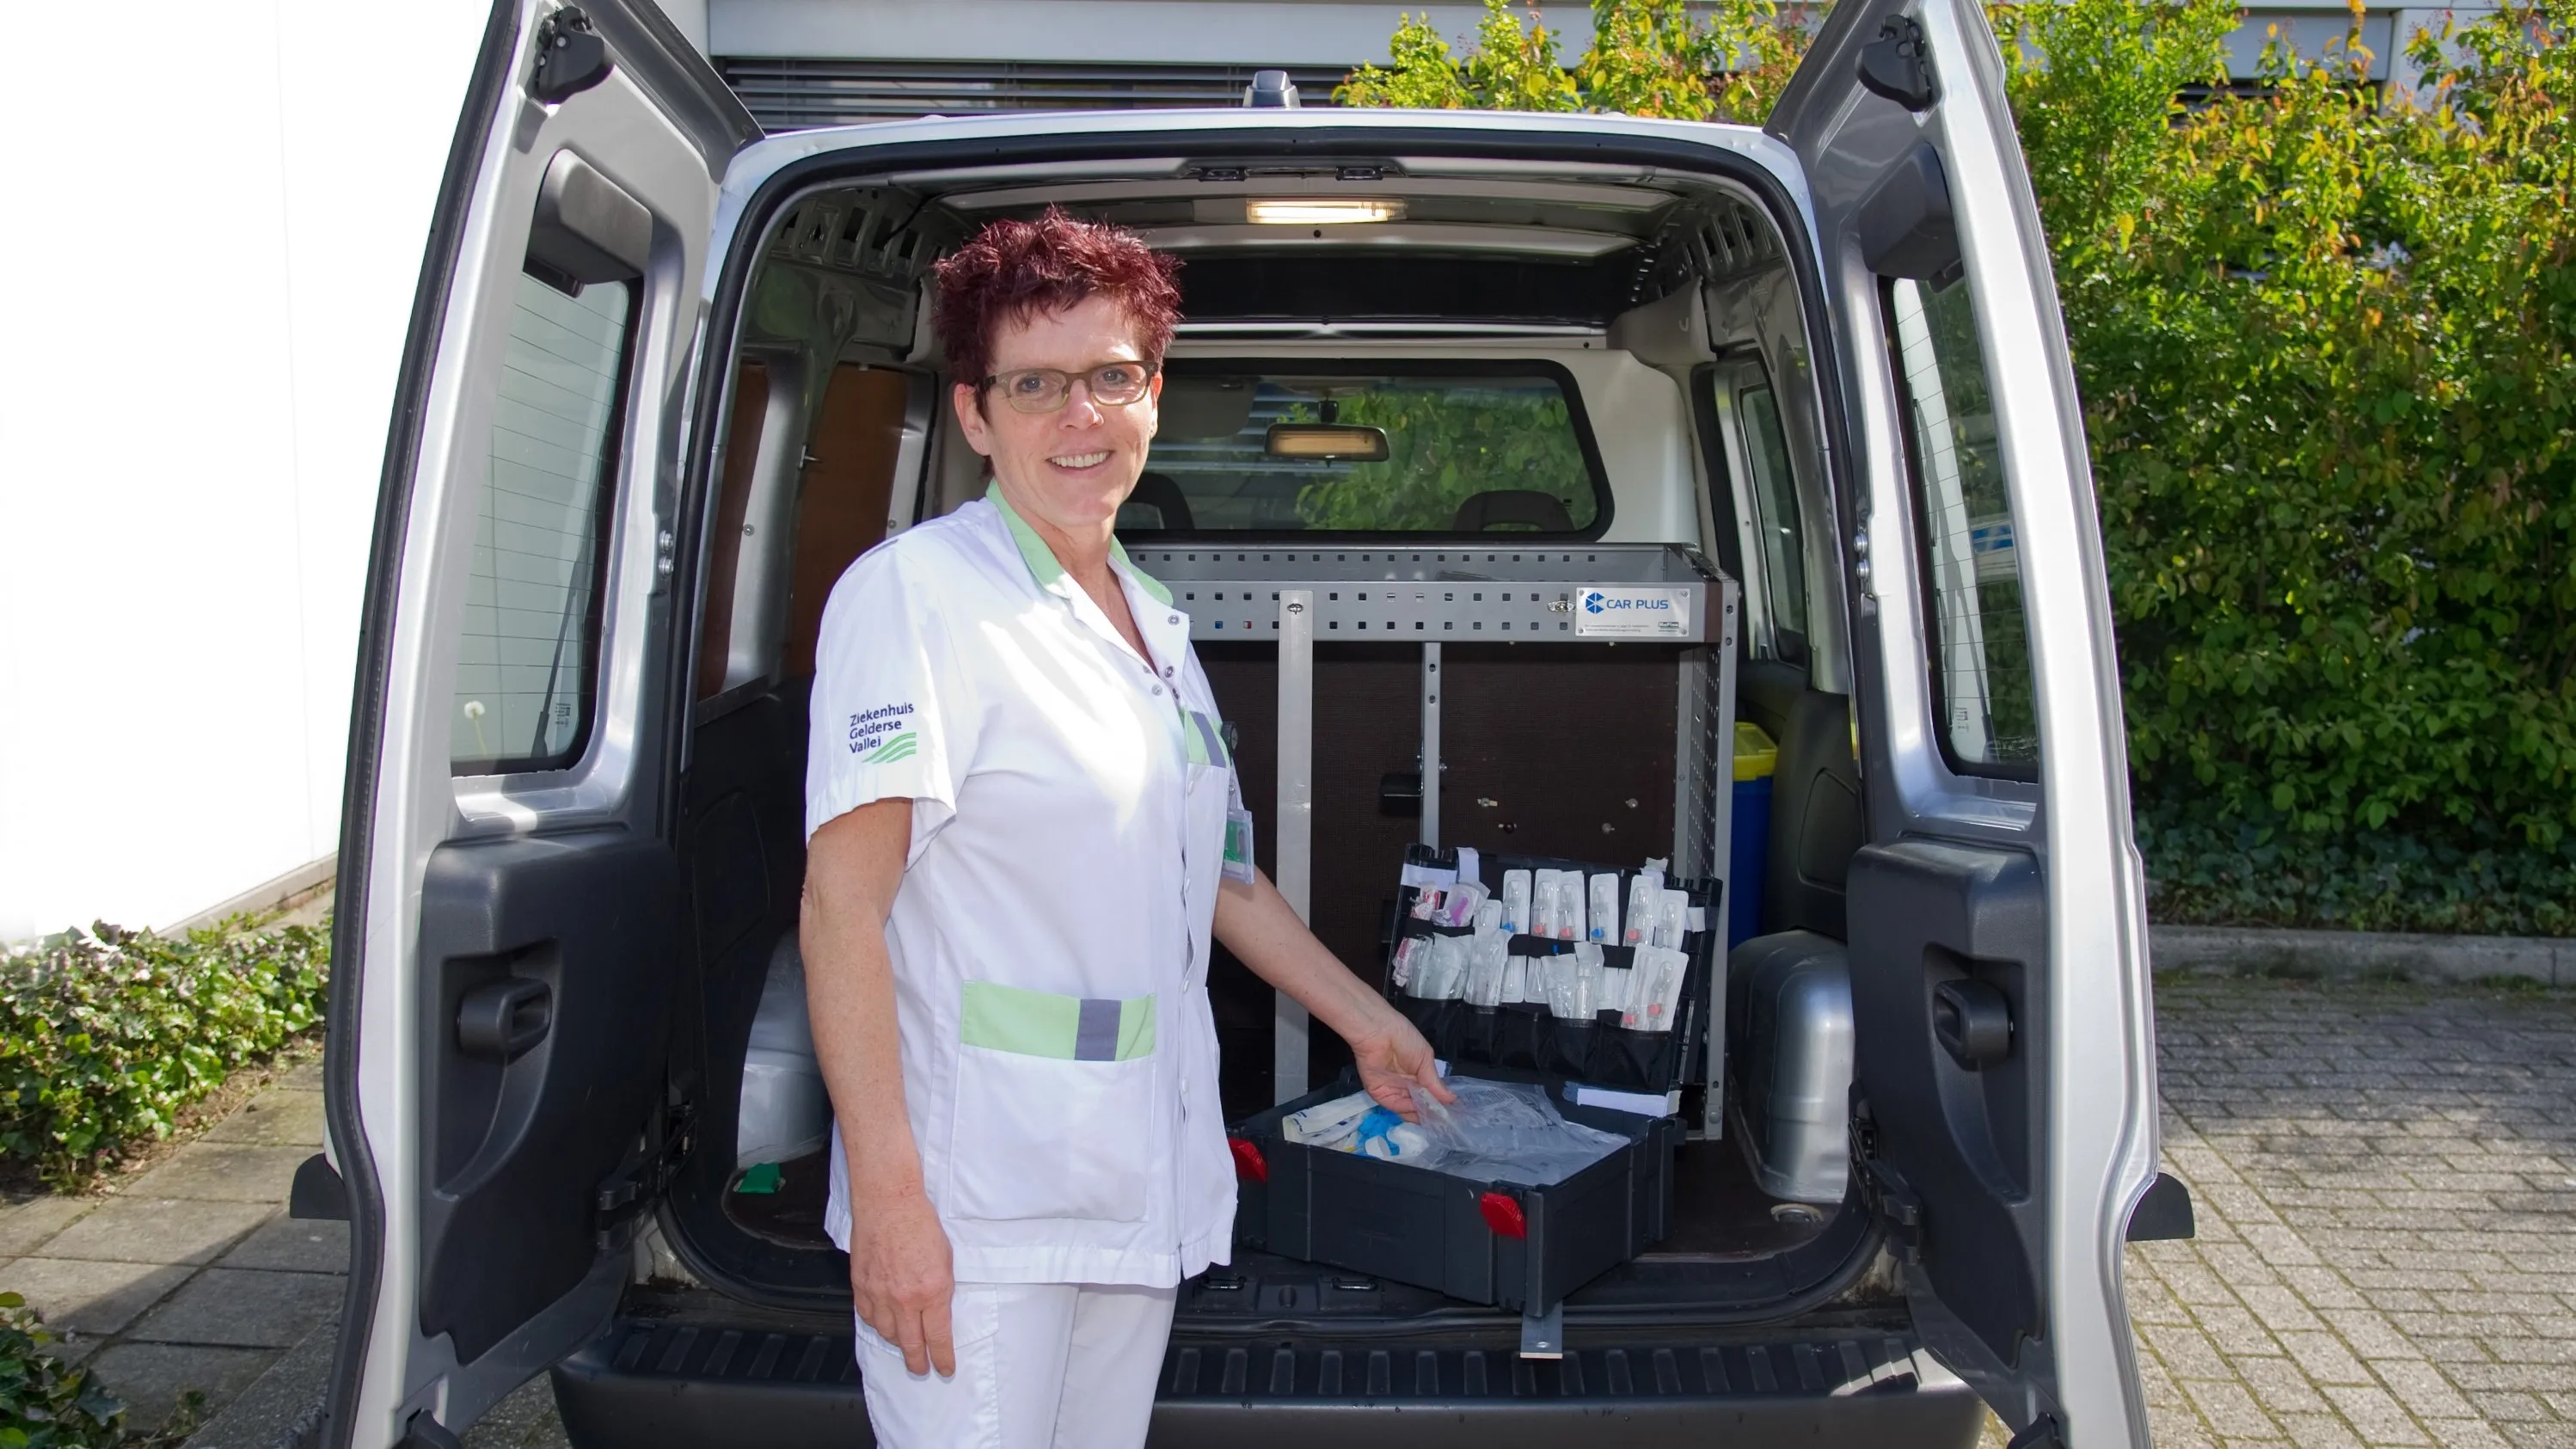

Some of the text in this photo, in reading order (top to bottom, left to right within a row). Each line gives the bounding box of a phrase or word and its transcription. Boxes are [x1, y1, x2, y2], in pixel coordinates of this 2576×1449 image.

[1606, 599, 1669, 609] CAR PLUS
[849, 702, 914, 727] Ziekenhuis
[849, 720, 902, 740] Gelderse
[849, 736, 881, 753] Vallei
